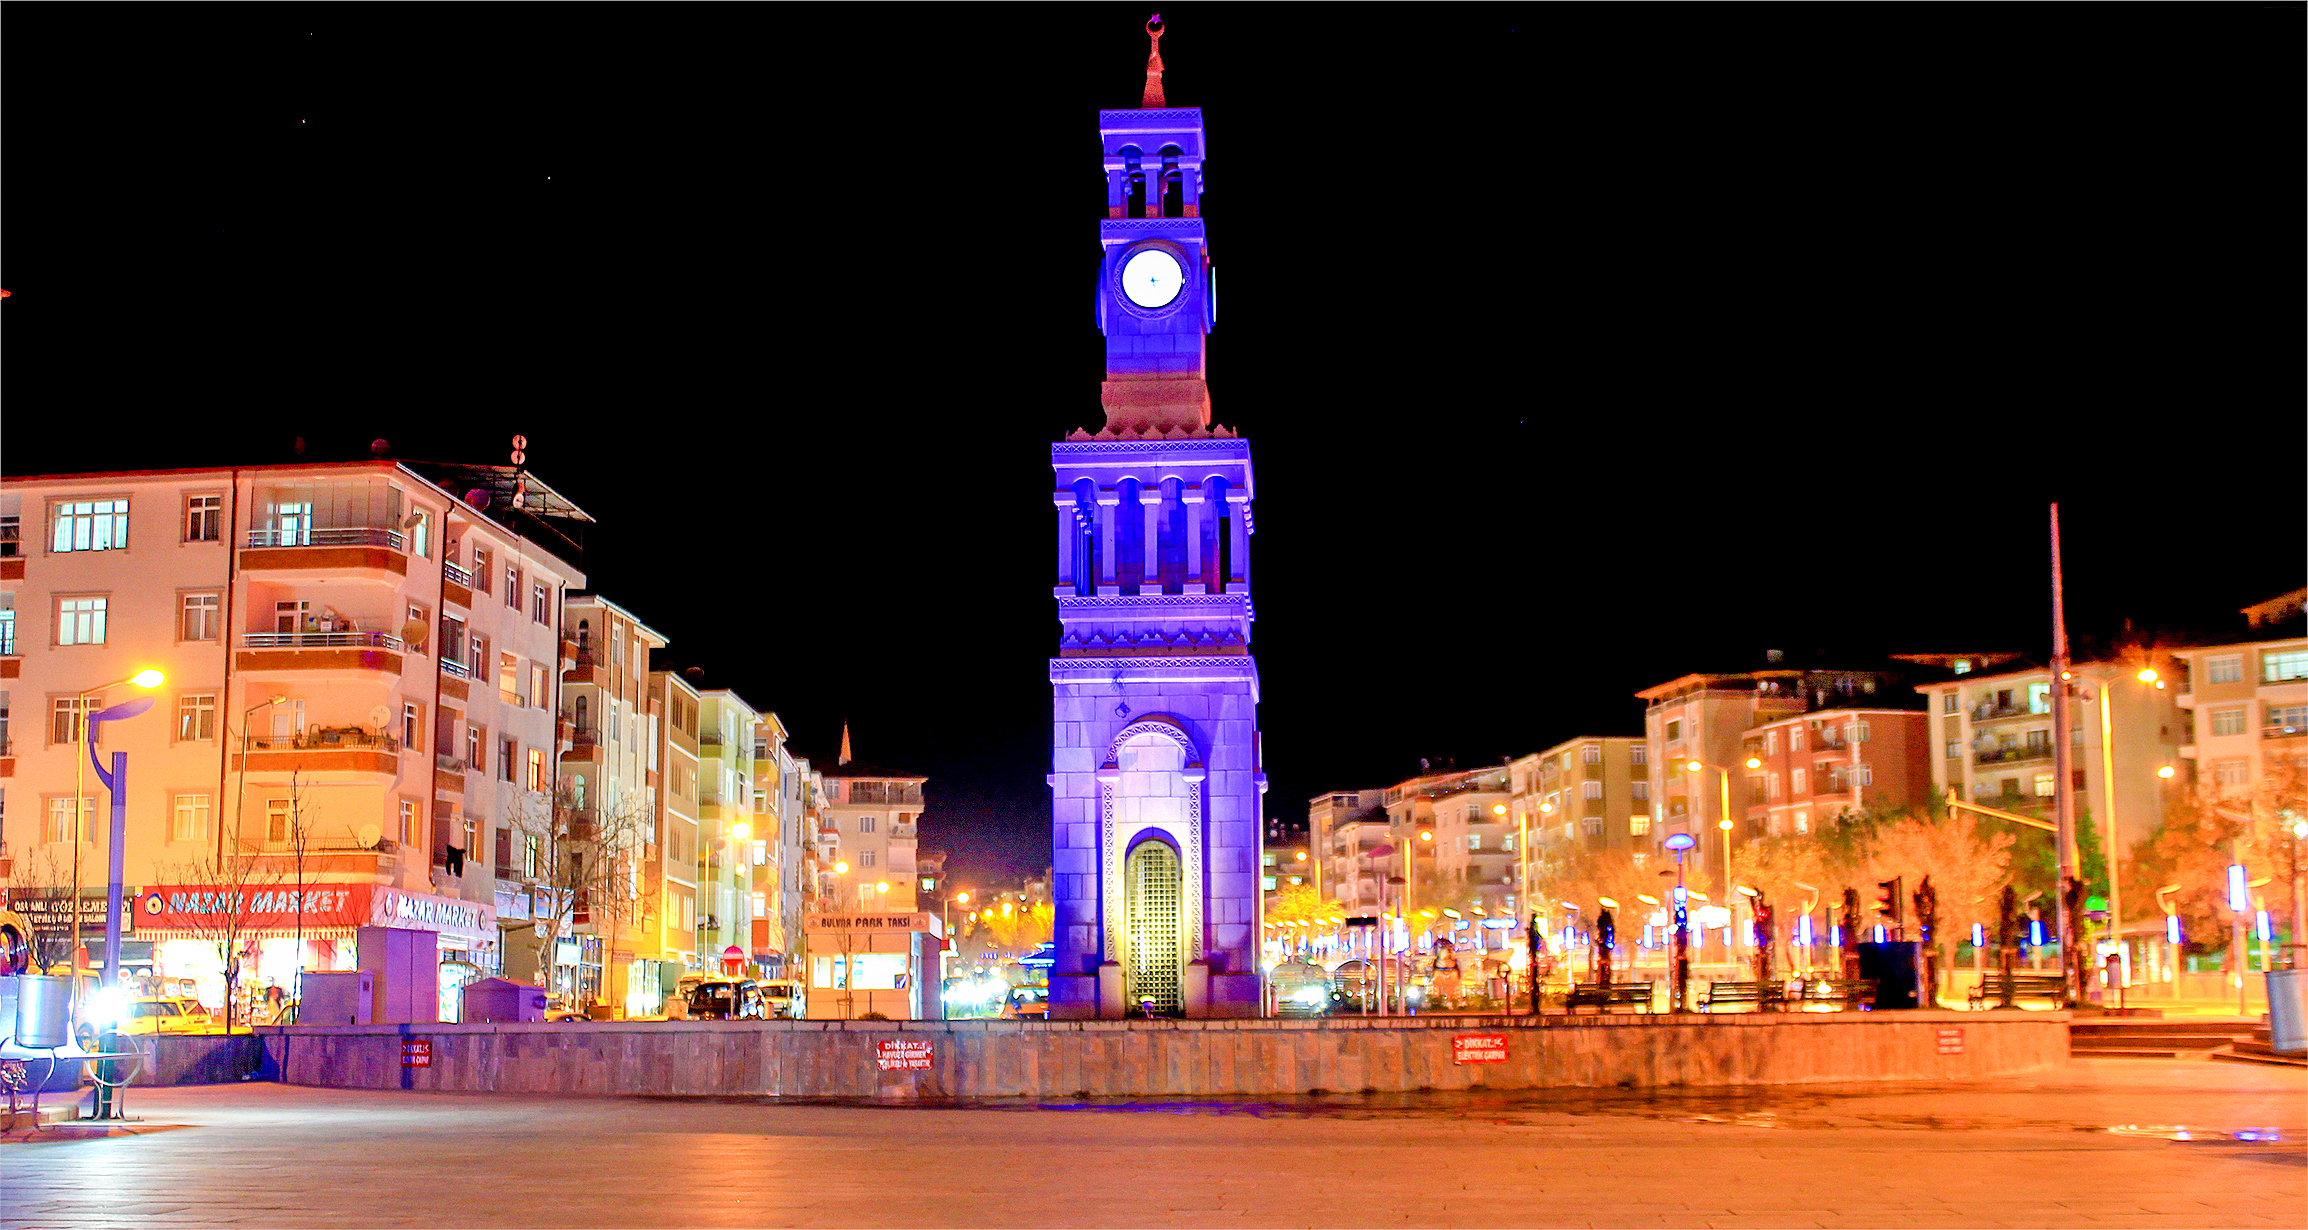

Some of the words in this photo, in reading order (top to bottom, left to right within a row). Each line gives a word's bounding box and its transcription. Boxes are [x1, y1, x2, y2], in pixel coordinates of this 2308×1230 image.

[51, 899, 107, 912] GÖZEME
[168, 891, 243, 914] NAZAR
[249, 891, 349, 914] MARKET
[397, 894, 434, 923] NAZAR
[435, 903, 477, 928] MARKET
[822, 918, 851, 928] BULVAR
[855, 917, 882, 928] PARK
[888, 916, 910, 928] TAKSİ
